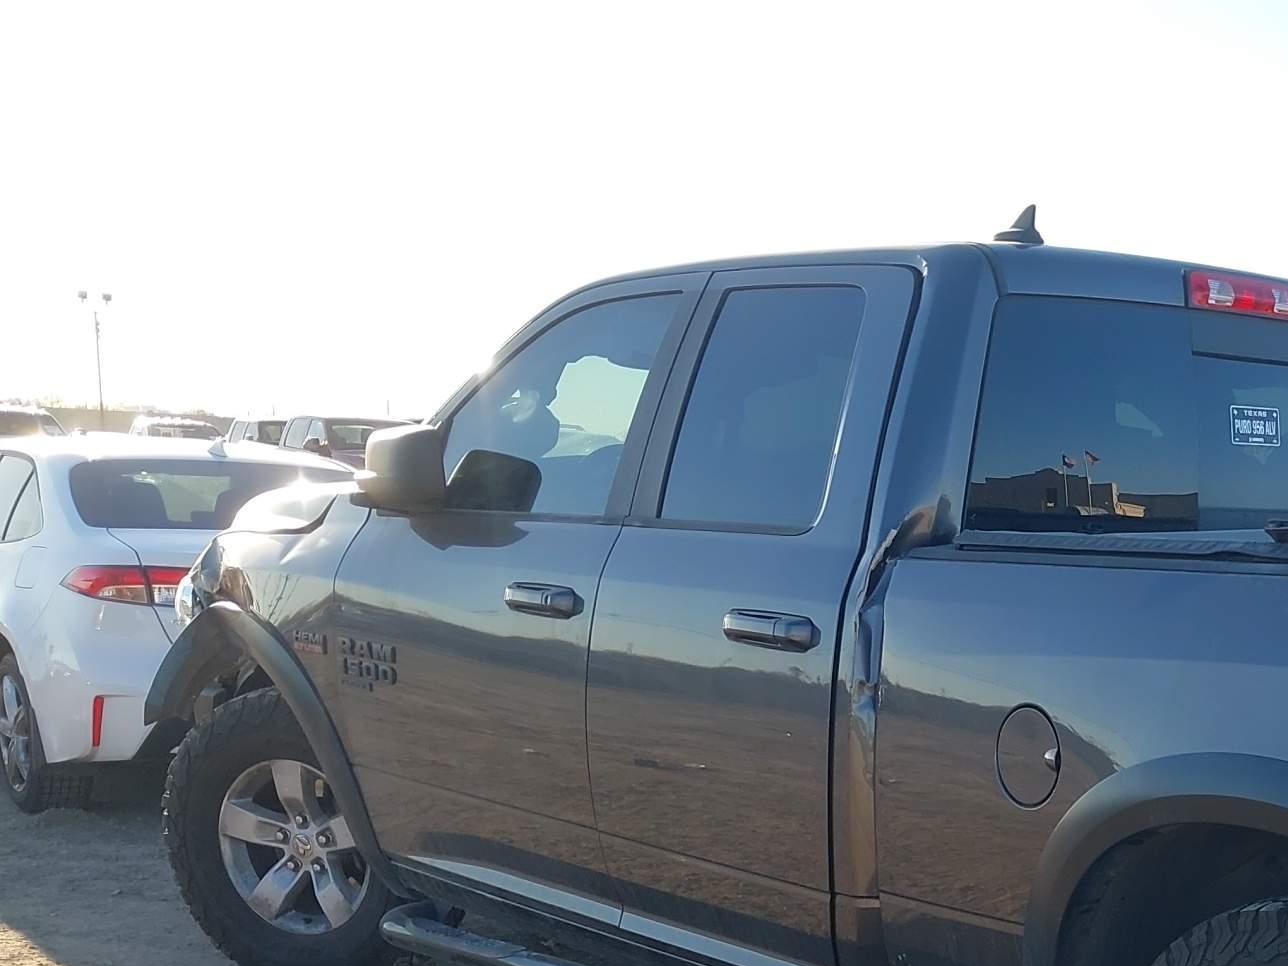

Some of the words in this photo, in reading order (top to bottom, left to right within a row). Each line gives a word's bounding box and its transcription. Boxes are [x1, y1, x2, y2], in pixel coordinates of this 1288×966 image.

[1243, 409, 1268, 418] TEXAS
[1234, 419, 1252, 434] PURO
[1252, 420, 1265, 435] 956
[1265, 421, 1276, 436] ALV
[292, 630, 325, 646] HEMI
[336, 636, 397, 664] RAM
